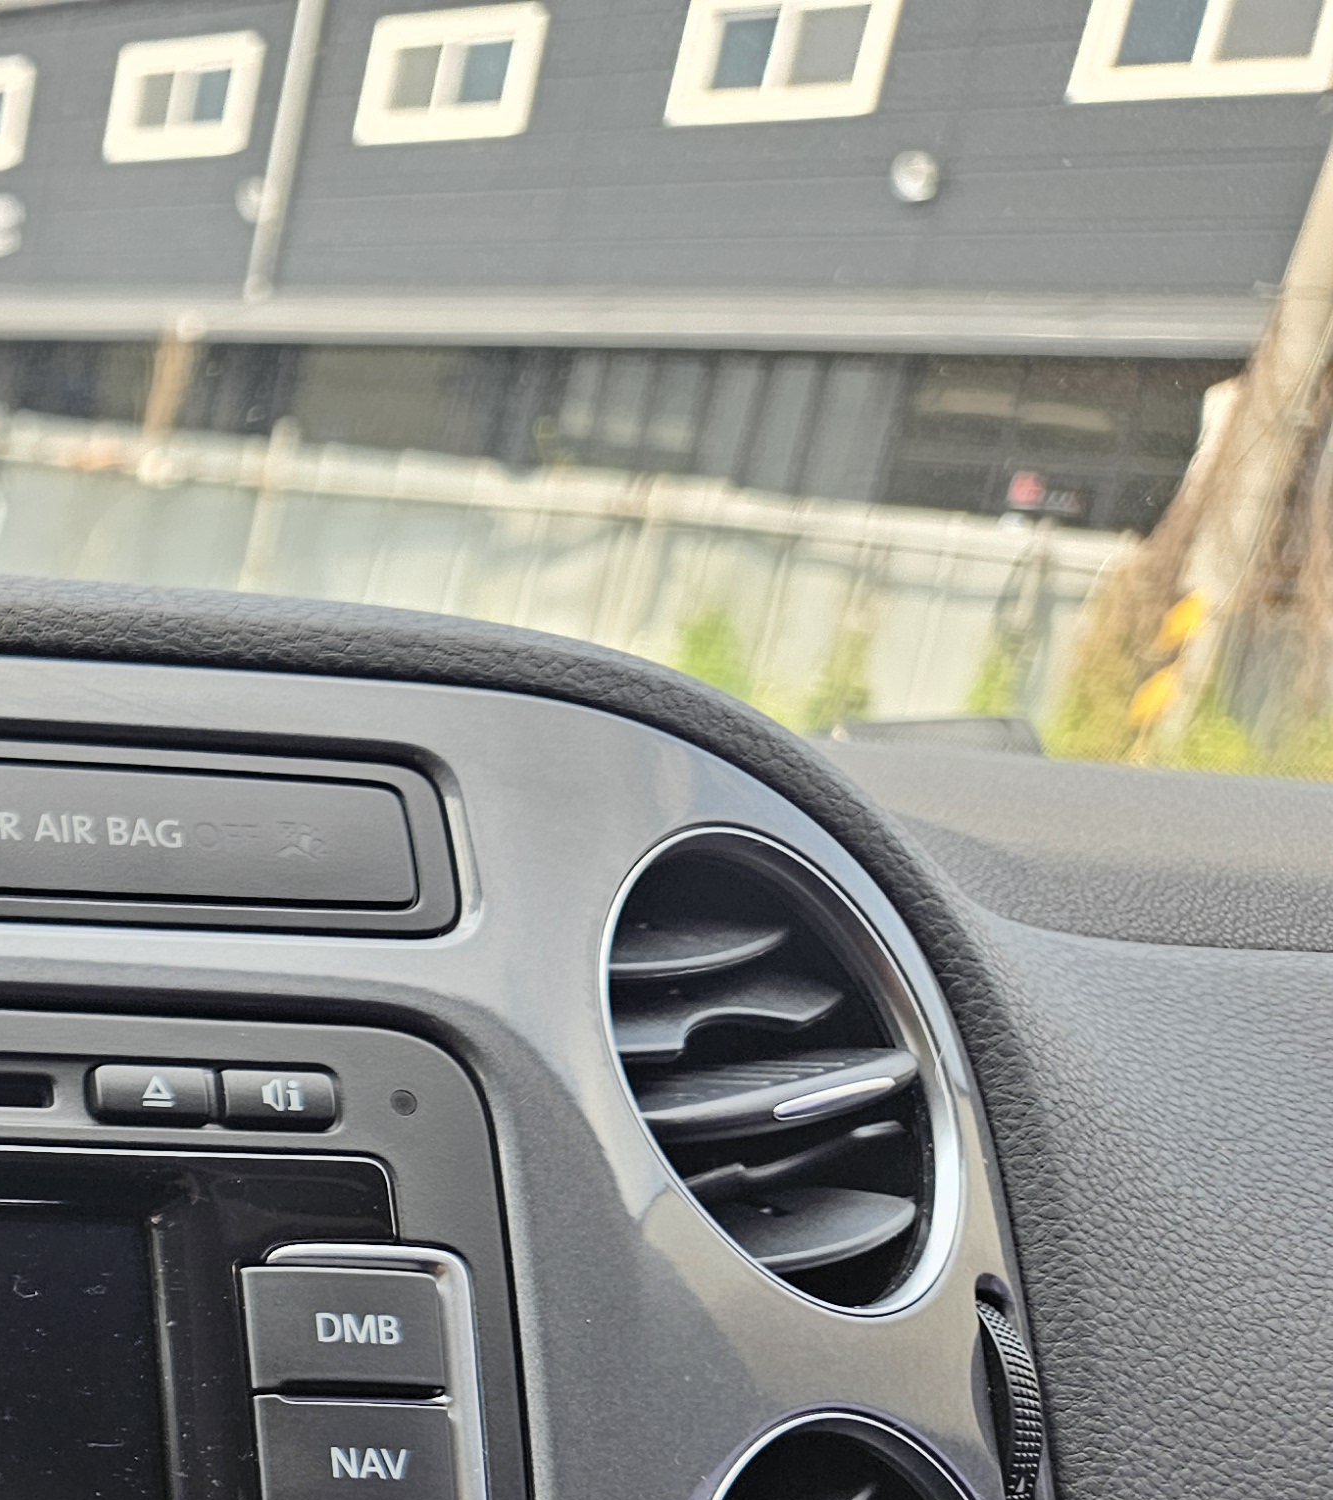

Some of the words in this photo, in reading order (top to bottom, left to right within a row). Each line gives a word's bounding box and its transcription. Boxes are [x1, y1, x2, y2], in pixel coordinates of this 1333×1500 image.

[34, 812, 97, 845] AIR
[107, 816, 182, 849] BAG
[315, 1312, 400, 1345] DMB
[330, 1446, 407, 1480] NAV
